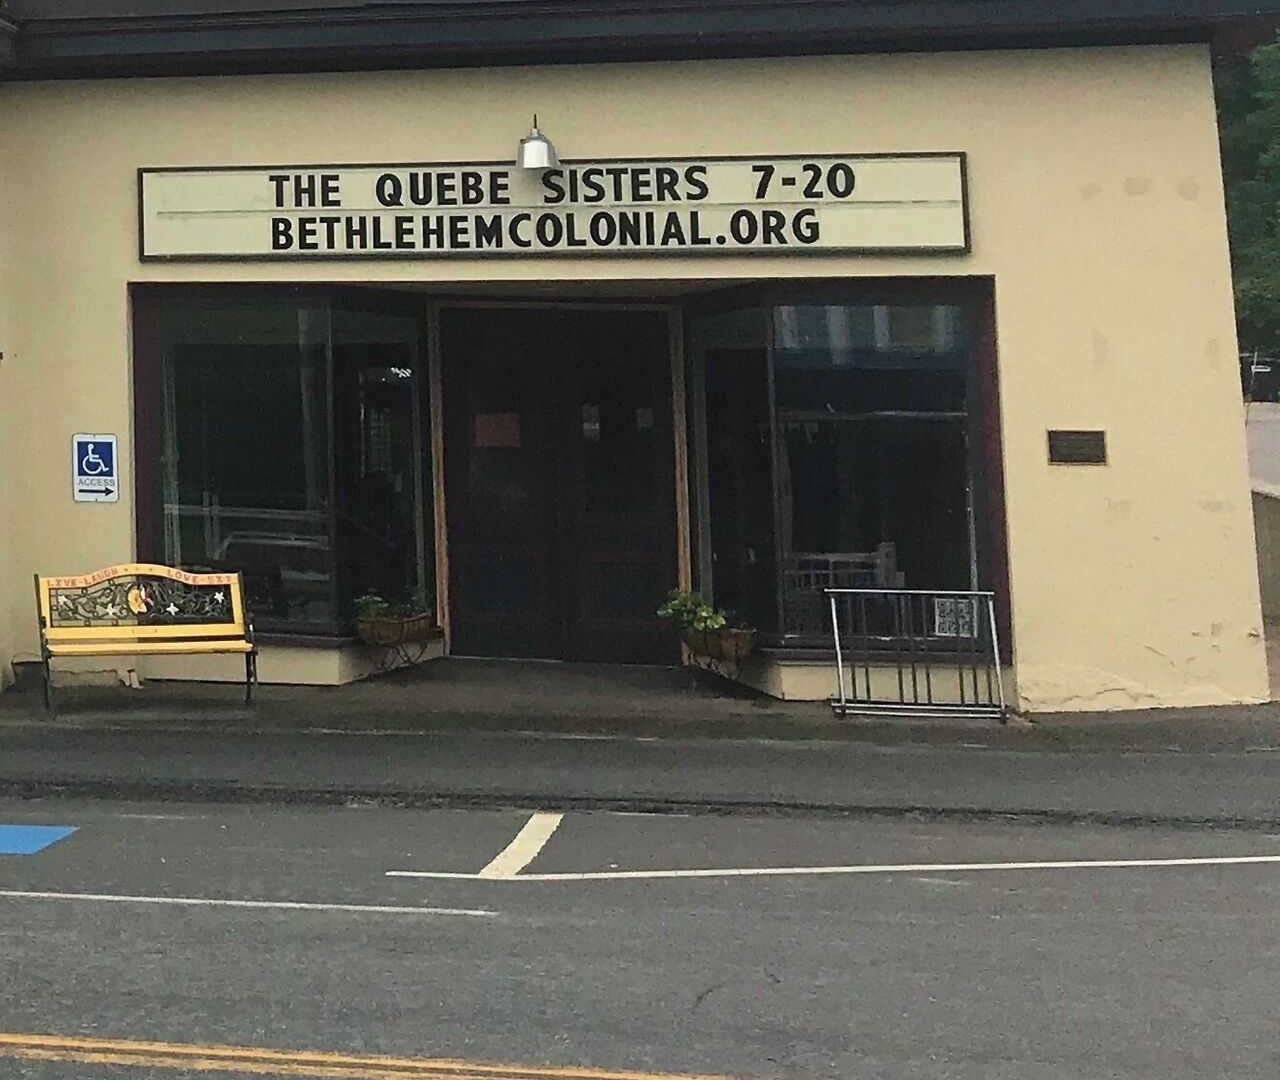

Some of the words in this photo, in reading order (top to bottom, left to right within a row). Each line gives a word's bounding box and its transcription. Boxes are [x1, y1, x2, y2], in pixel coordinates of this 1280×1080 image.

[269, 174, 342, 207] THE
[375, 170, 511, 207] QUEBE
[541, 165, 709, 204] SISTERS
[751, 162, 856, 200] 7-20
[271, 208, 820, 250] BETHLEHEMCOLONIAL.ORG
[78, 478, 116, 487] ACCESS
